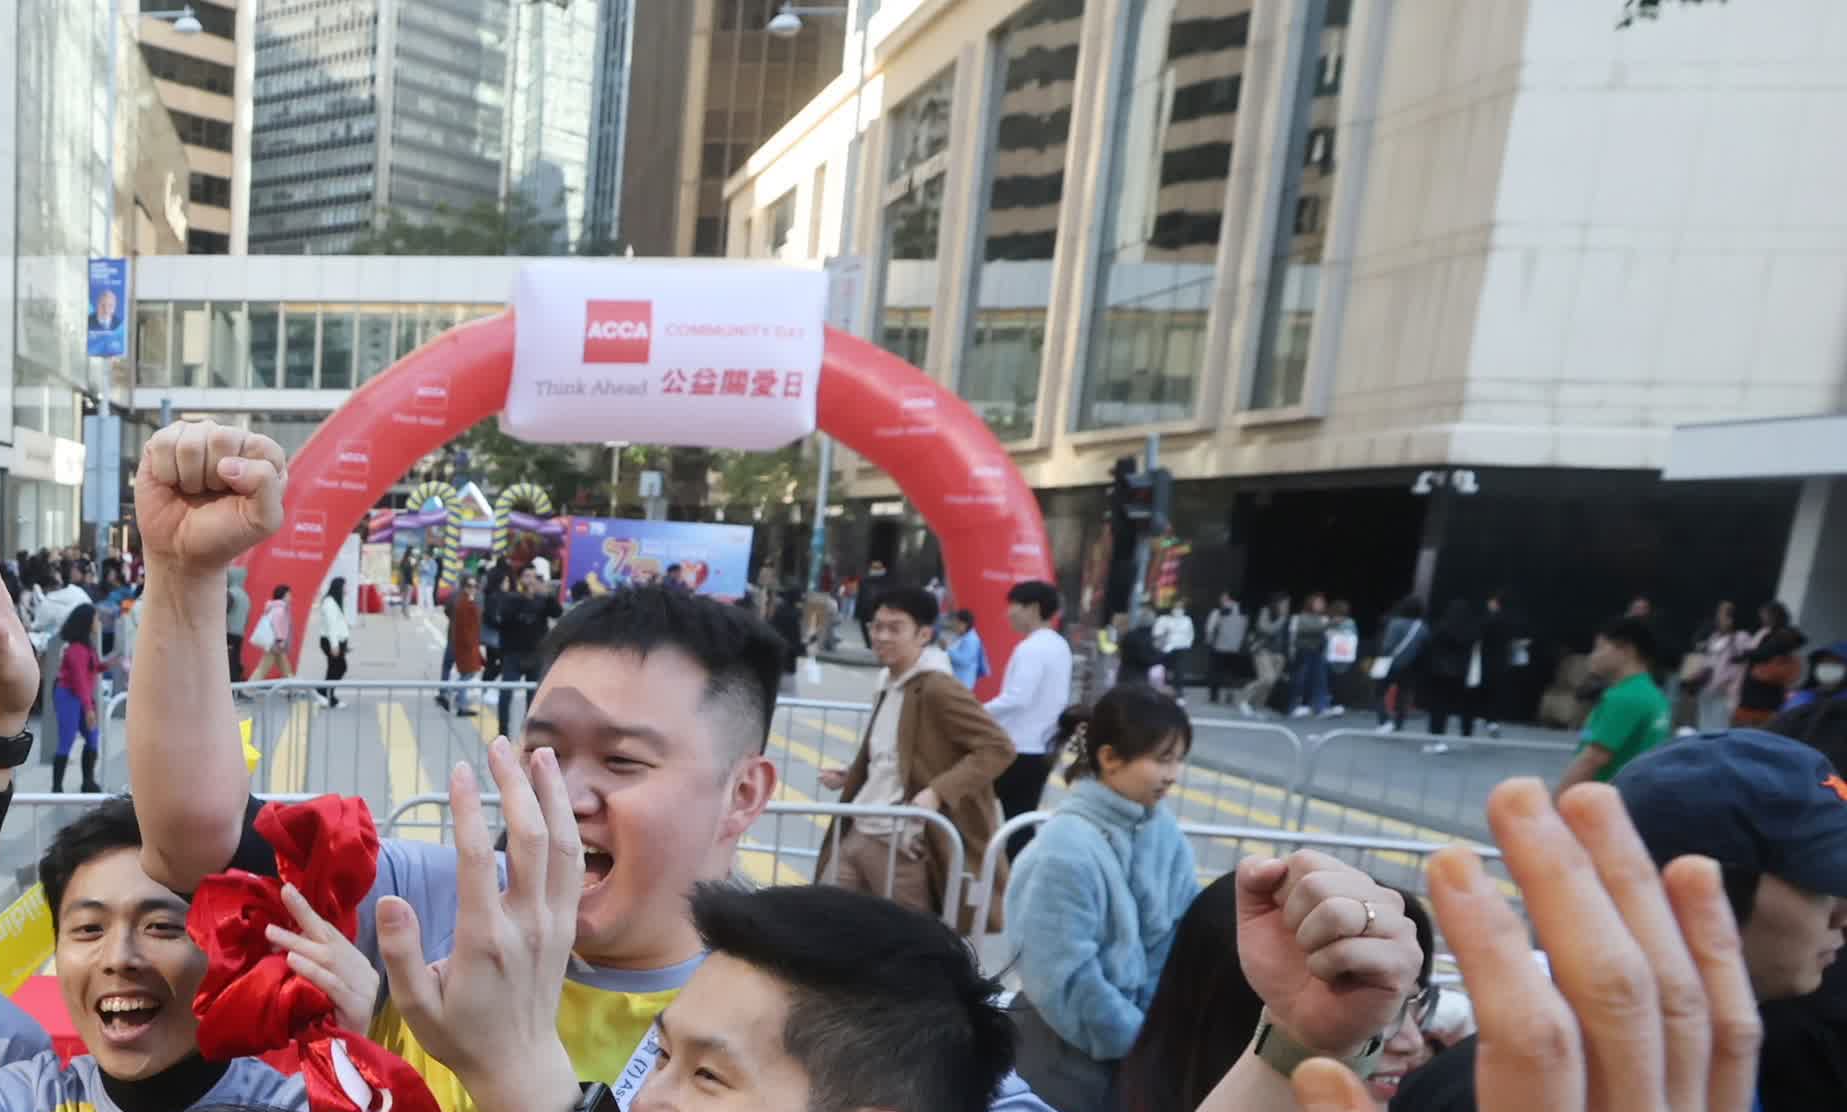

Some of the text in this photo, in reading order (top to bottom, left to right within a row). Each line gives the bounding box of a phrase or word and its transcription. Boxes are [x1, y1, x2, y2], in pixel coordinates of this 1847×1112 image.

[586, 319, 650, 340] ACCA
[663, 322, 770, 338] COMMUNITY
[537, 379, 649, 397] Think Ahead
[661, 367, 805, 399] 公益關愛日
